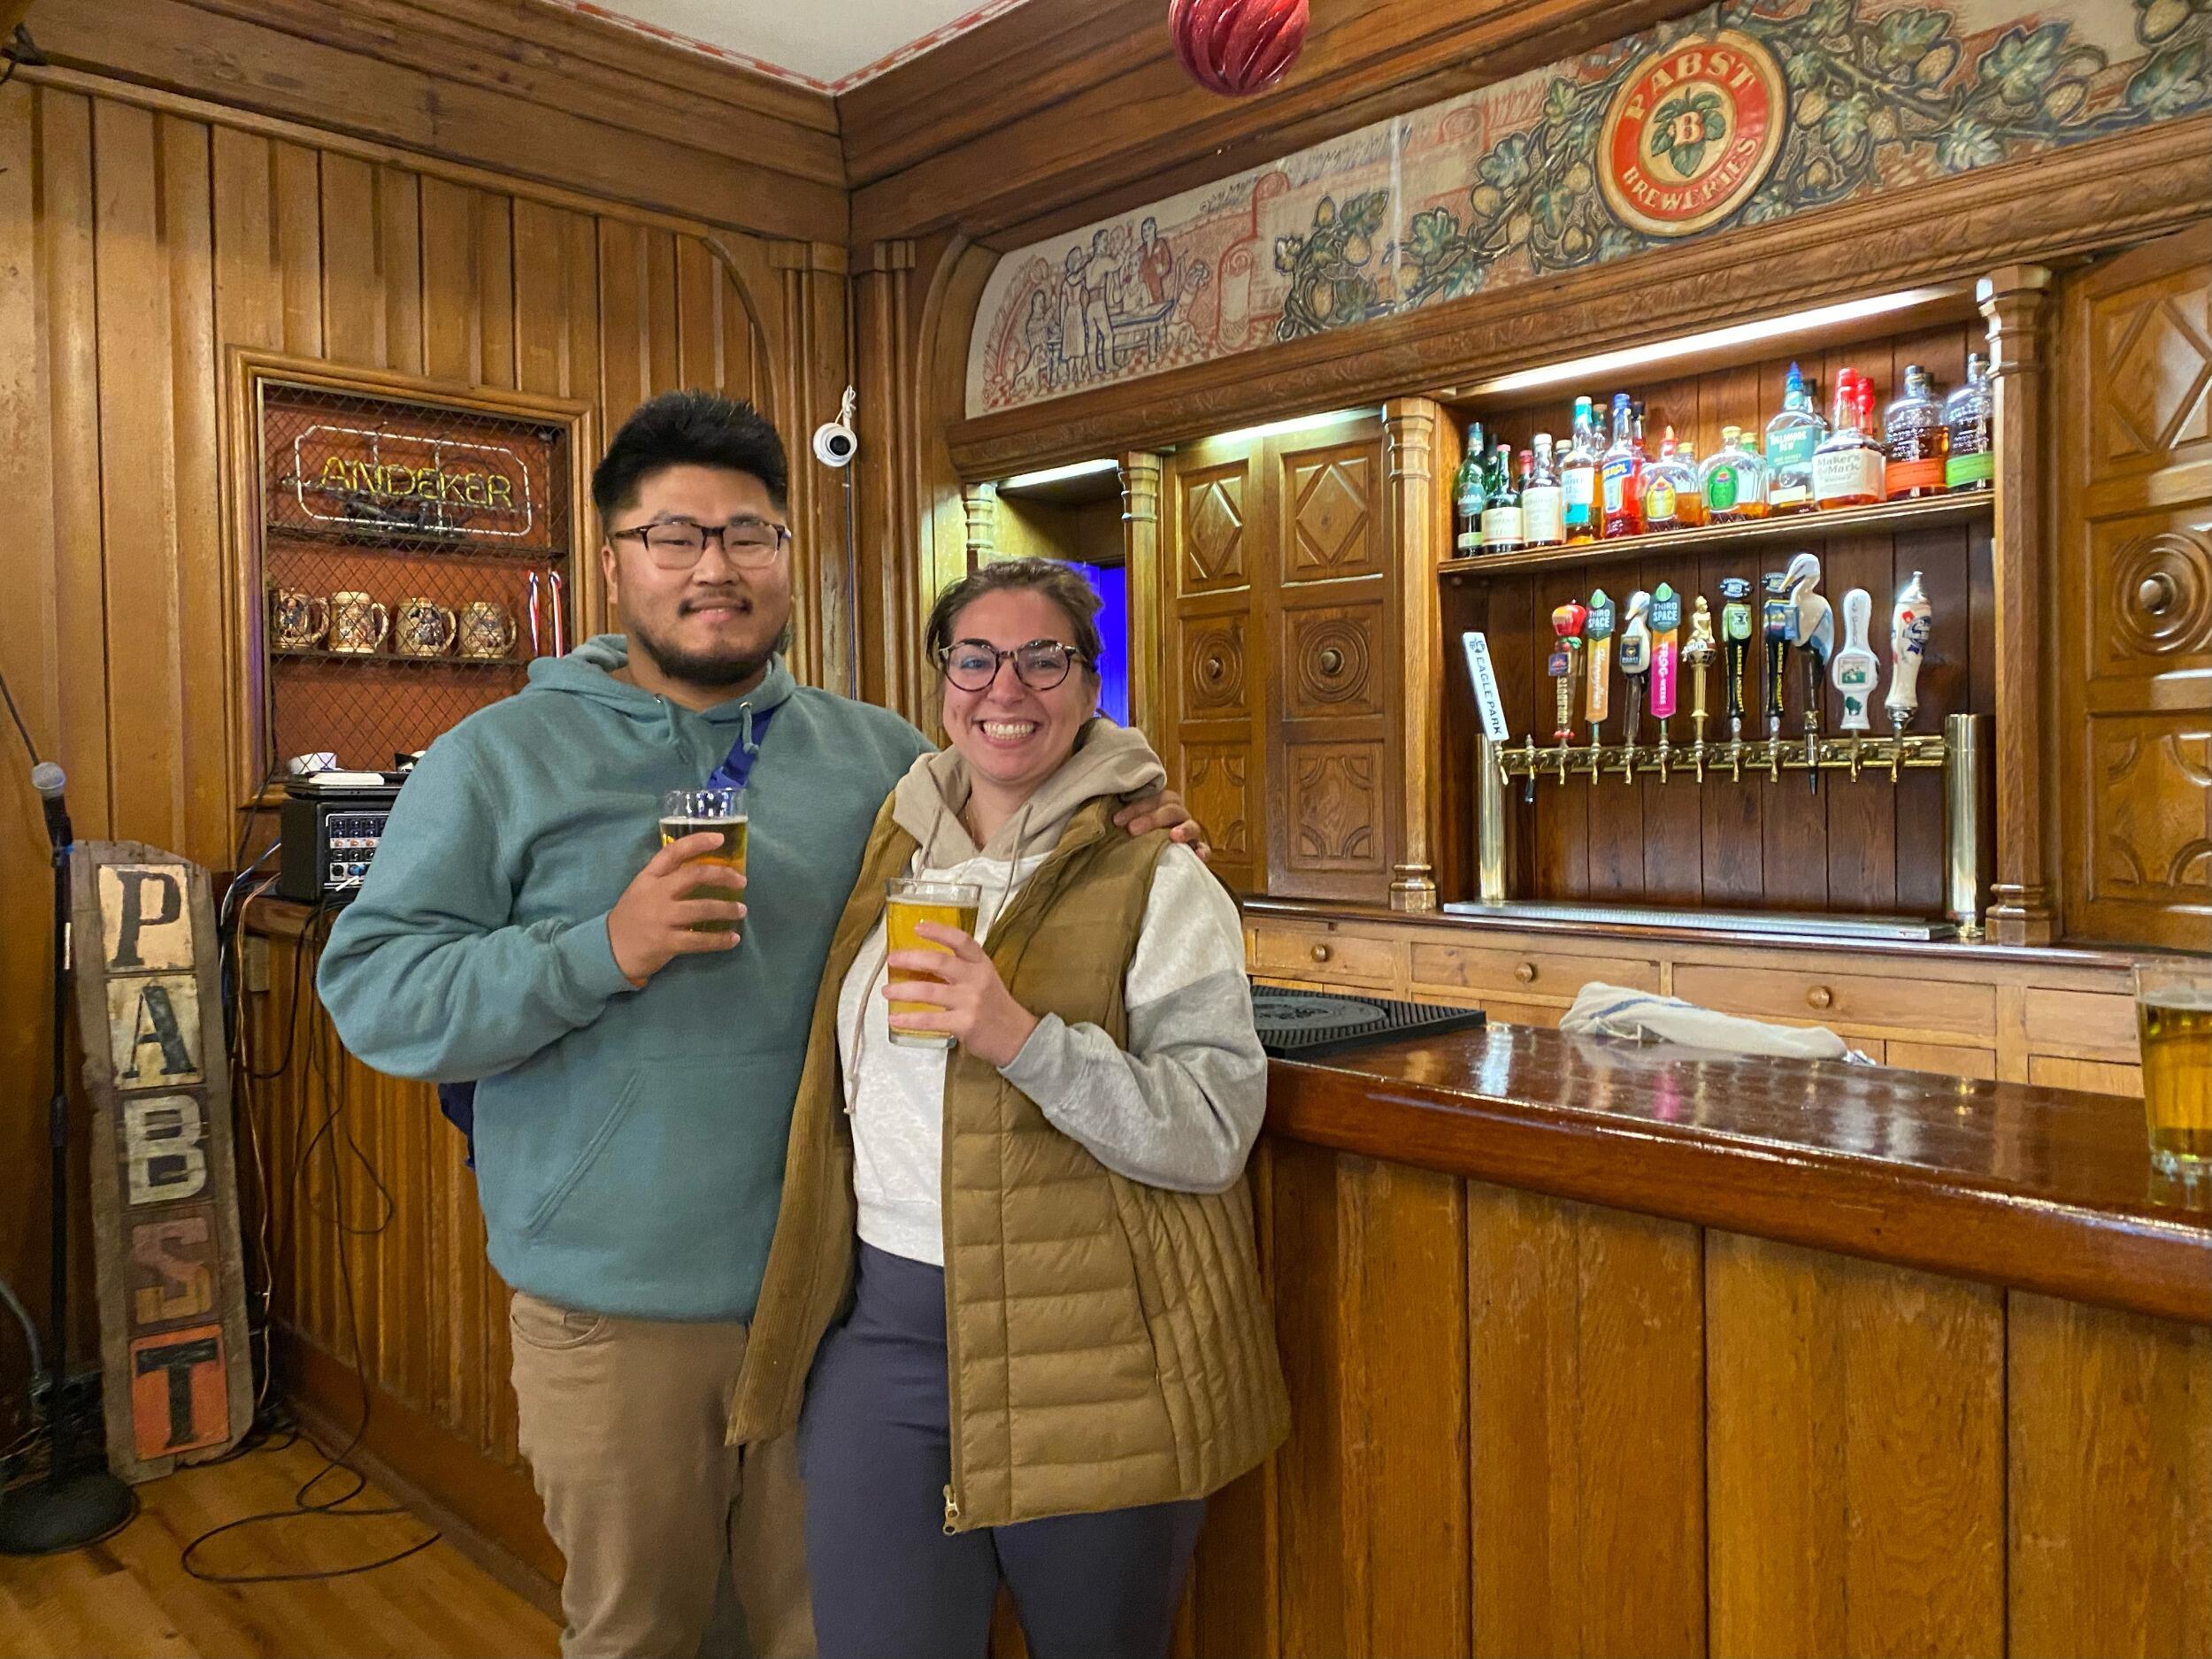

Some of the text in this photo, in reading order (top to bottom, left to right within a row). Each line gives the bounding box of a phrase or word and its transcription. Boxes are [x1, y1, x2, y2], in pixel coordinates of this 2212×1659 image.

[1624, 51, 1756, 120] PABST
[1674, 111, 1705, 146] B
[1623, 137, 1756, 211] BREWERIES
[320, 457, 512, 508] ANDEKER
[1828, 463, 1860, 474] Mark
[1588, 609, 1610, 618] THIRD
[1588, 617, 1610, 627] SPACE
[1653, 611, 1678, 621] SPACE
[1477, 657, 1489, 700] EAGLE
[1487, 701, 1502, 735] PARK
[112, 869, 220, 1449] PABST
